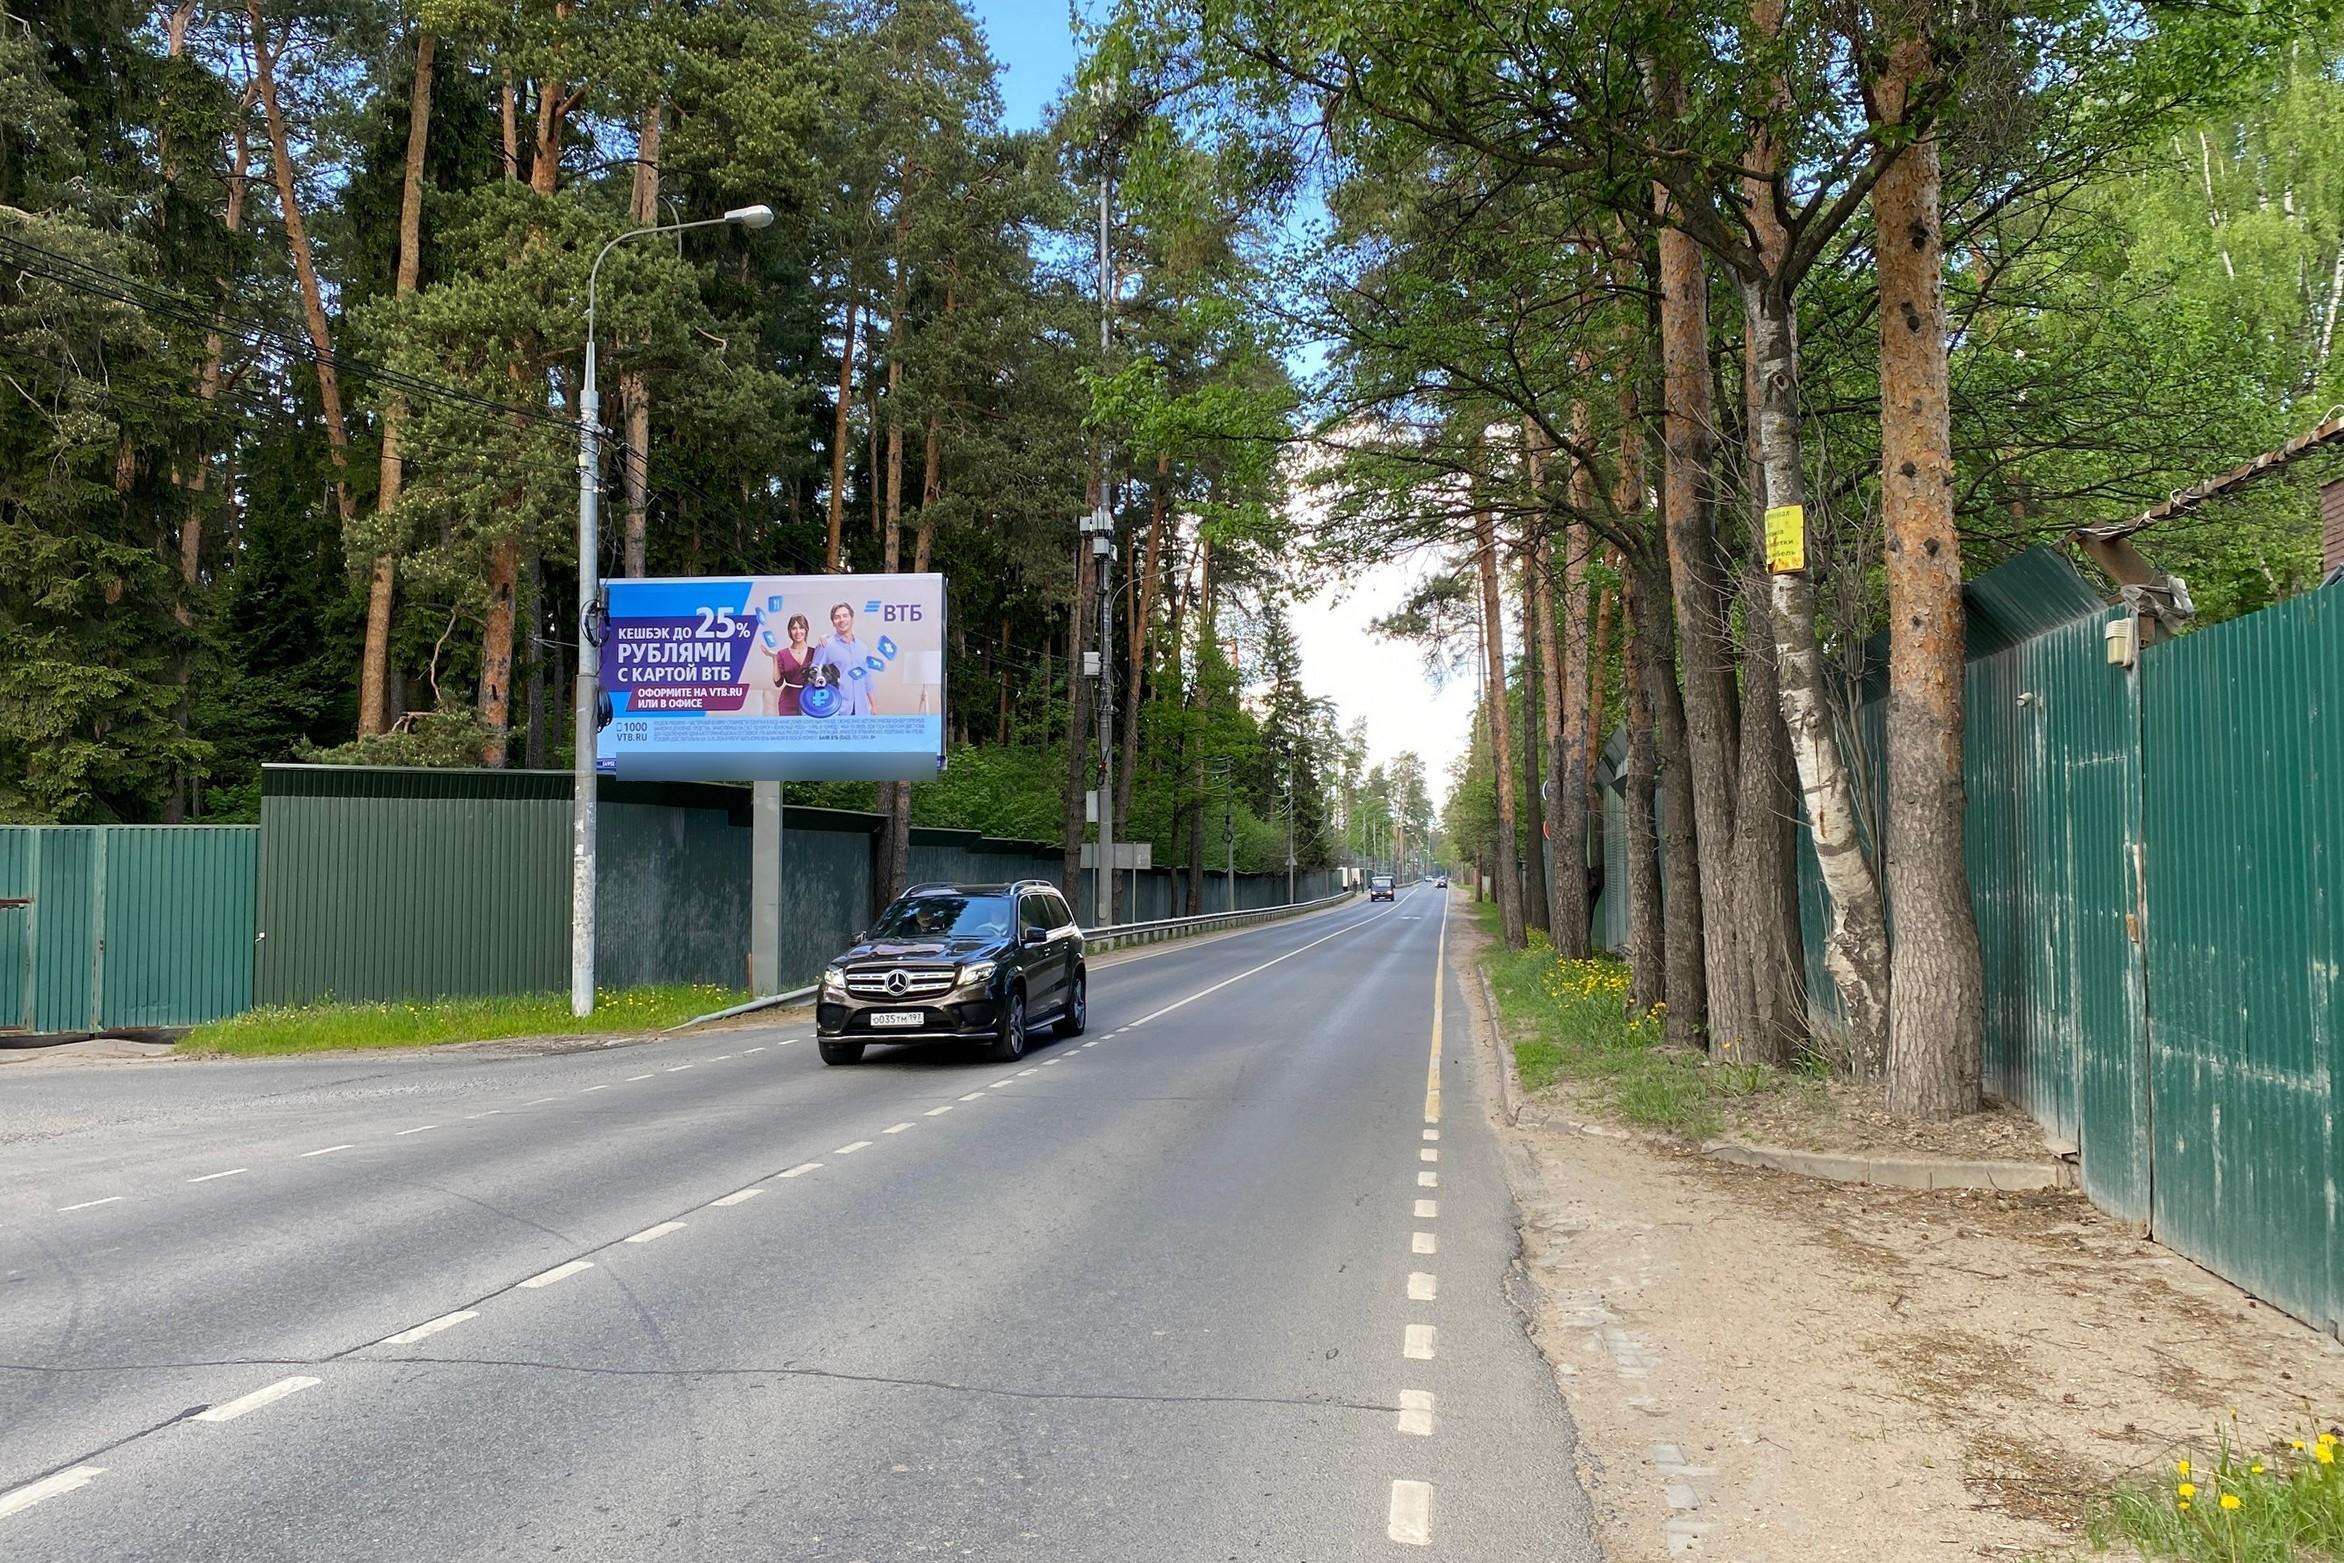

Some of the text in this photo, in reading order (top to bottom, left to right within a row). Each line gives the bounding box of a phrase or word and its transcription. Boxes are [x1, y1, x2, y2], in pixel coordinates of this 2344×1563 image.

[884, 604, 922, 622] ВТБ
[618, 606, 751, 641] КЕШБЭК ДО 25%
[617, 641, 731, 663] РУБЛЯМИ
[617, 663, 731, 682] С КАРТОЙ ВТБ
[637, 687, 743, 698] ОФОРМИТЕ НА VTB.RU
[637, 698, 703, 709] ИЛИ В ОФИСЕ
[624, 722, 648, 732] 1000
[616, 733, 648, 742] VTB.RU
